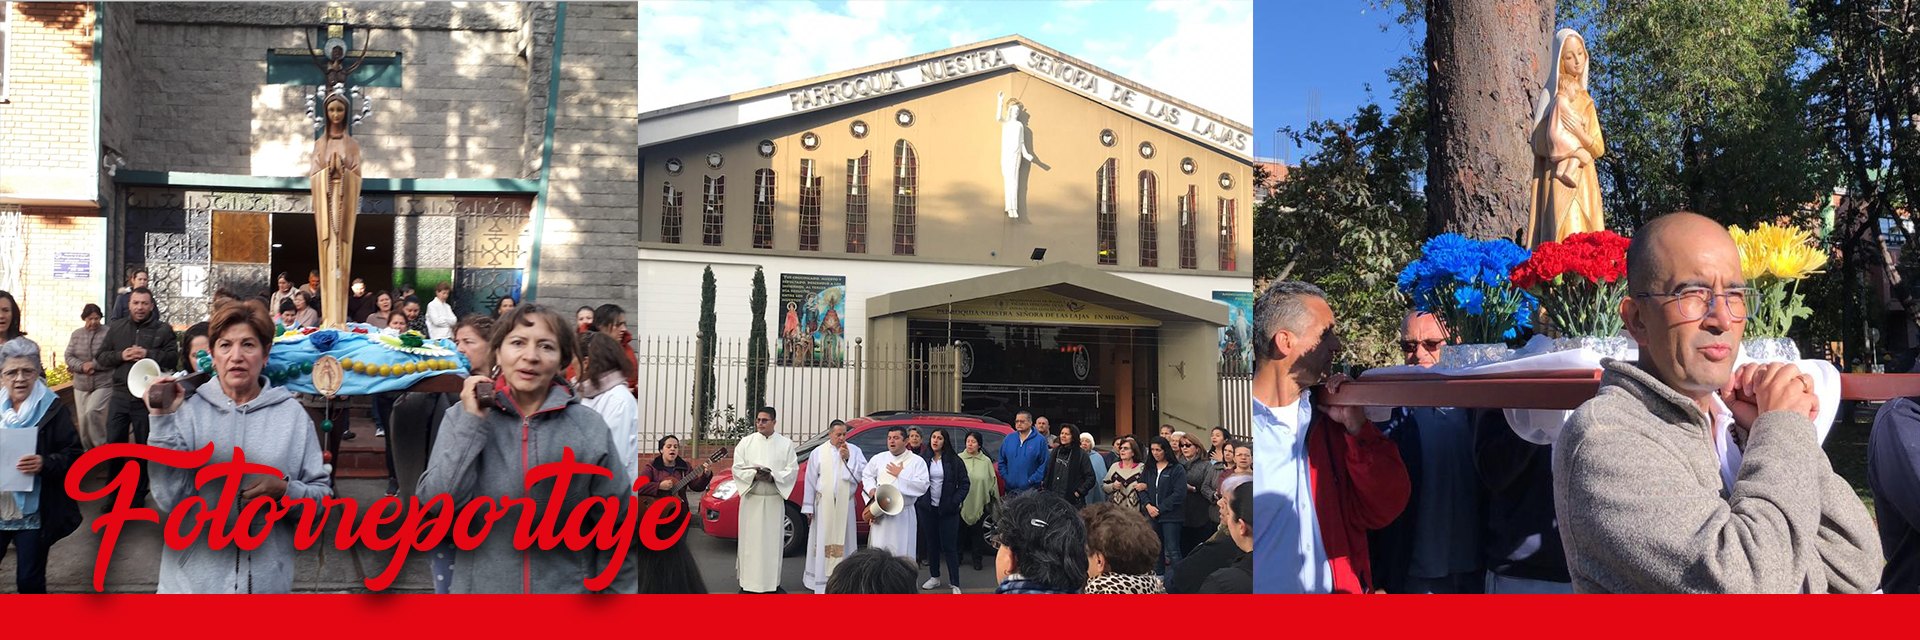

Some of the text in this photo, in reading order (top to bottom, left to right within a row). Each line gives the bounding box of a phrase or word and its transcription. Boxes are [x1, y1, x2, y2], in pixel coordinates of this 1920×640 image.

[788, 48, 1248, 151] PARROQUIA NUESTRA SEÑORA DE LAS LAJAS
[937, 309, 979, 317] PARROQUIA
[1016, 310, 1044, 318] SEÑORA
[1069, 312, 1090, 320] LAJAS
